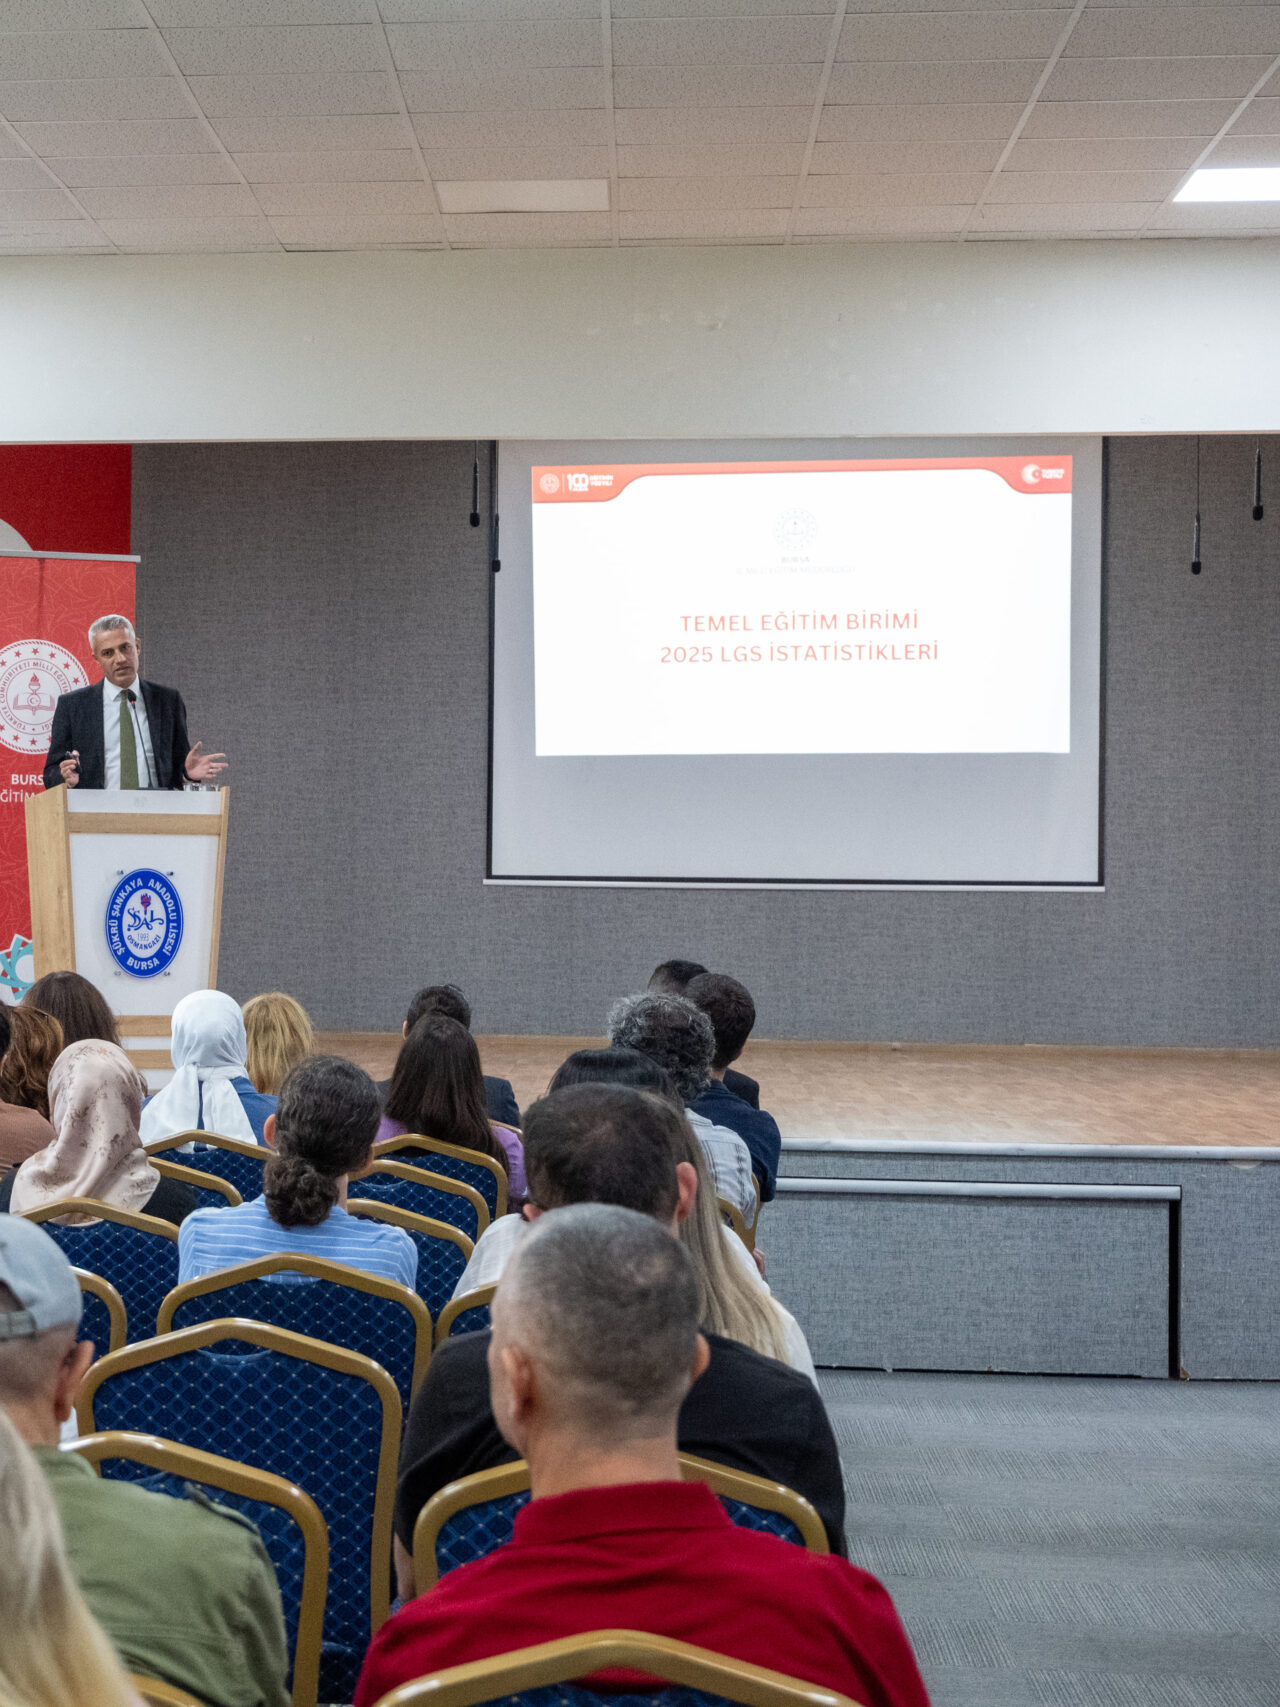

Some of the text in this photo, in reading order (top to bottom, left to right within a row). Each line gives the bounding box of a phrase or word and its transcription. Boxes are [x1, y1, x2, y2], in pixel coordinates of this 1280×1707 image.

[680, 608, 918, 632] TEMEL EĞİTİM BİRİMİ
[661, 640, 938, 663] 2025 LGS İSTATİSTİKLERİ
[11, 774, 44, 785] BURS
[148, 879, 176, 920] ANADOLU
[126, 957, 160, 970] BURSA
